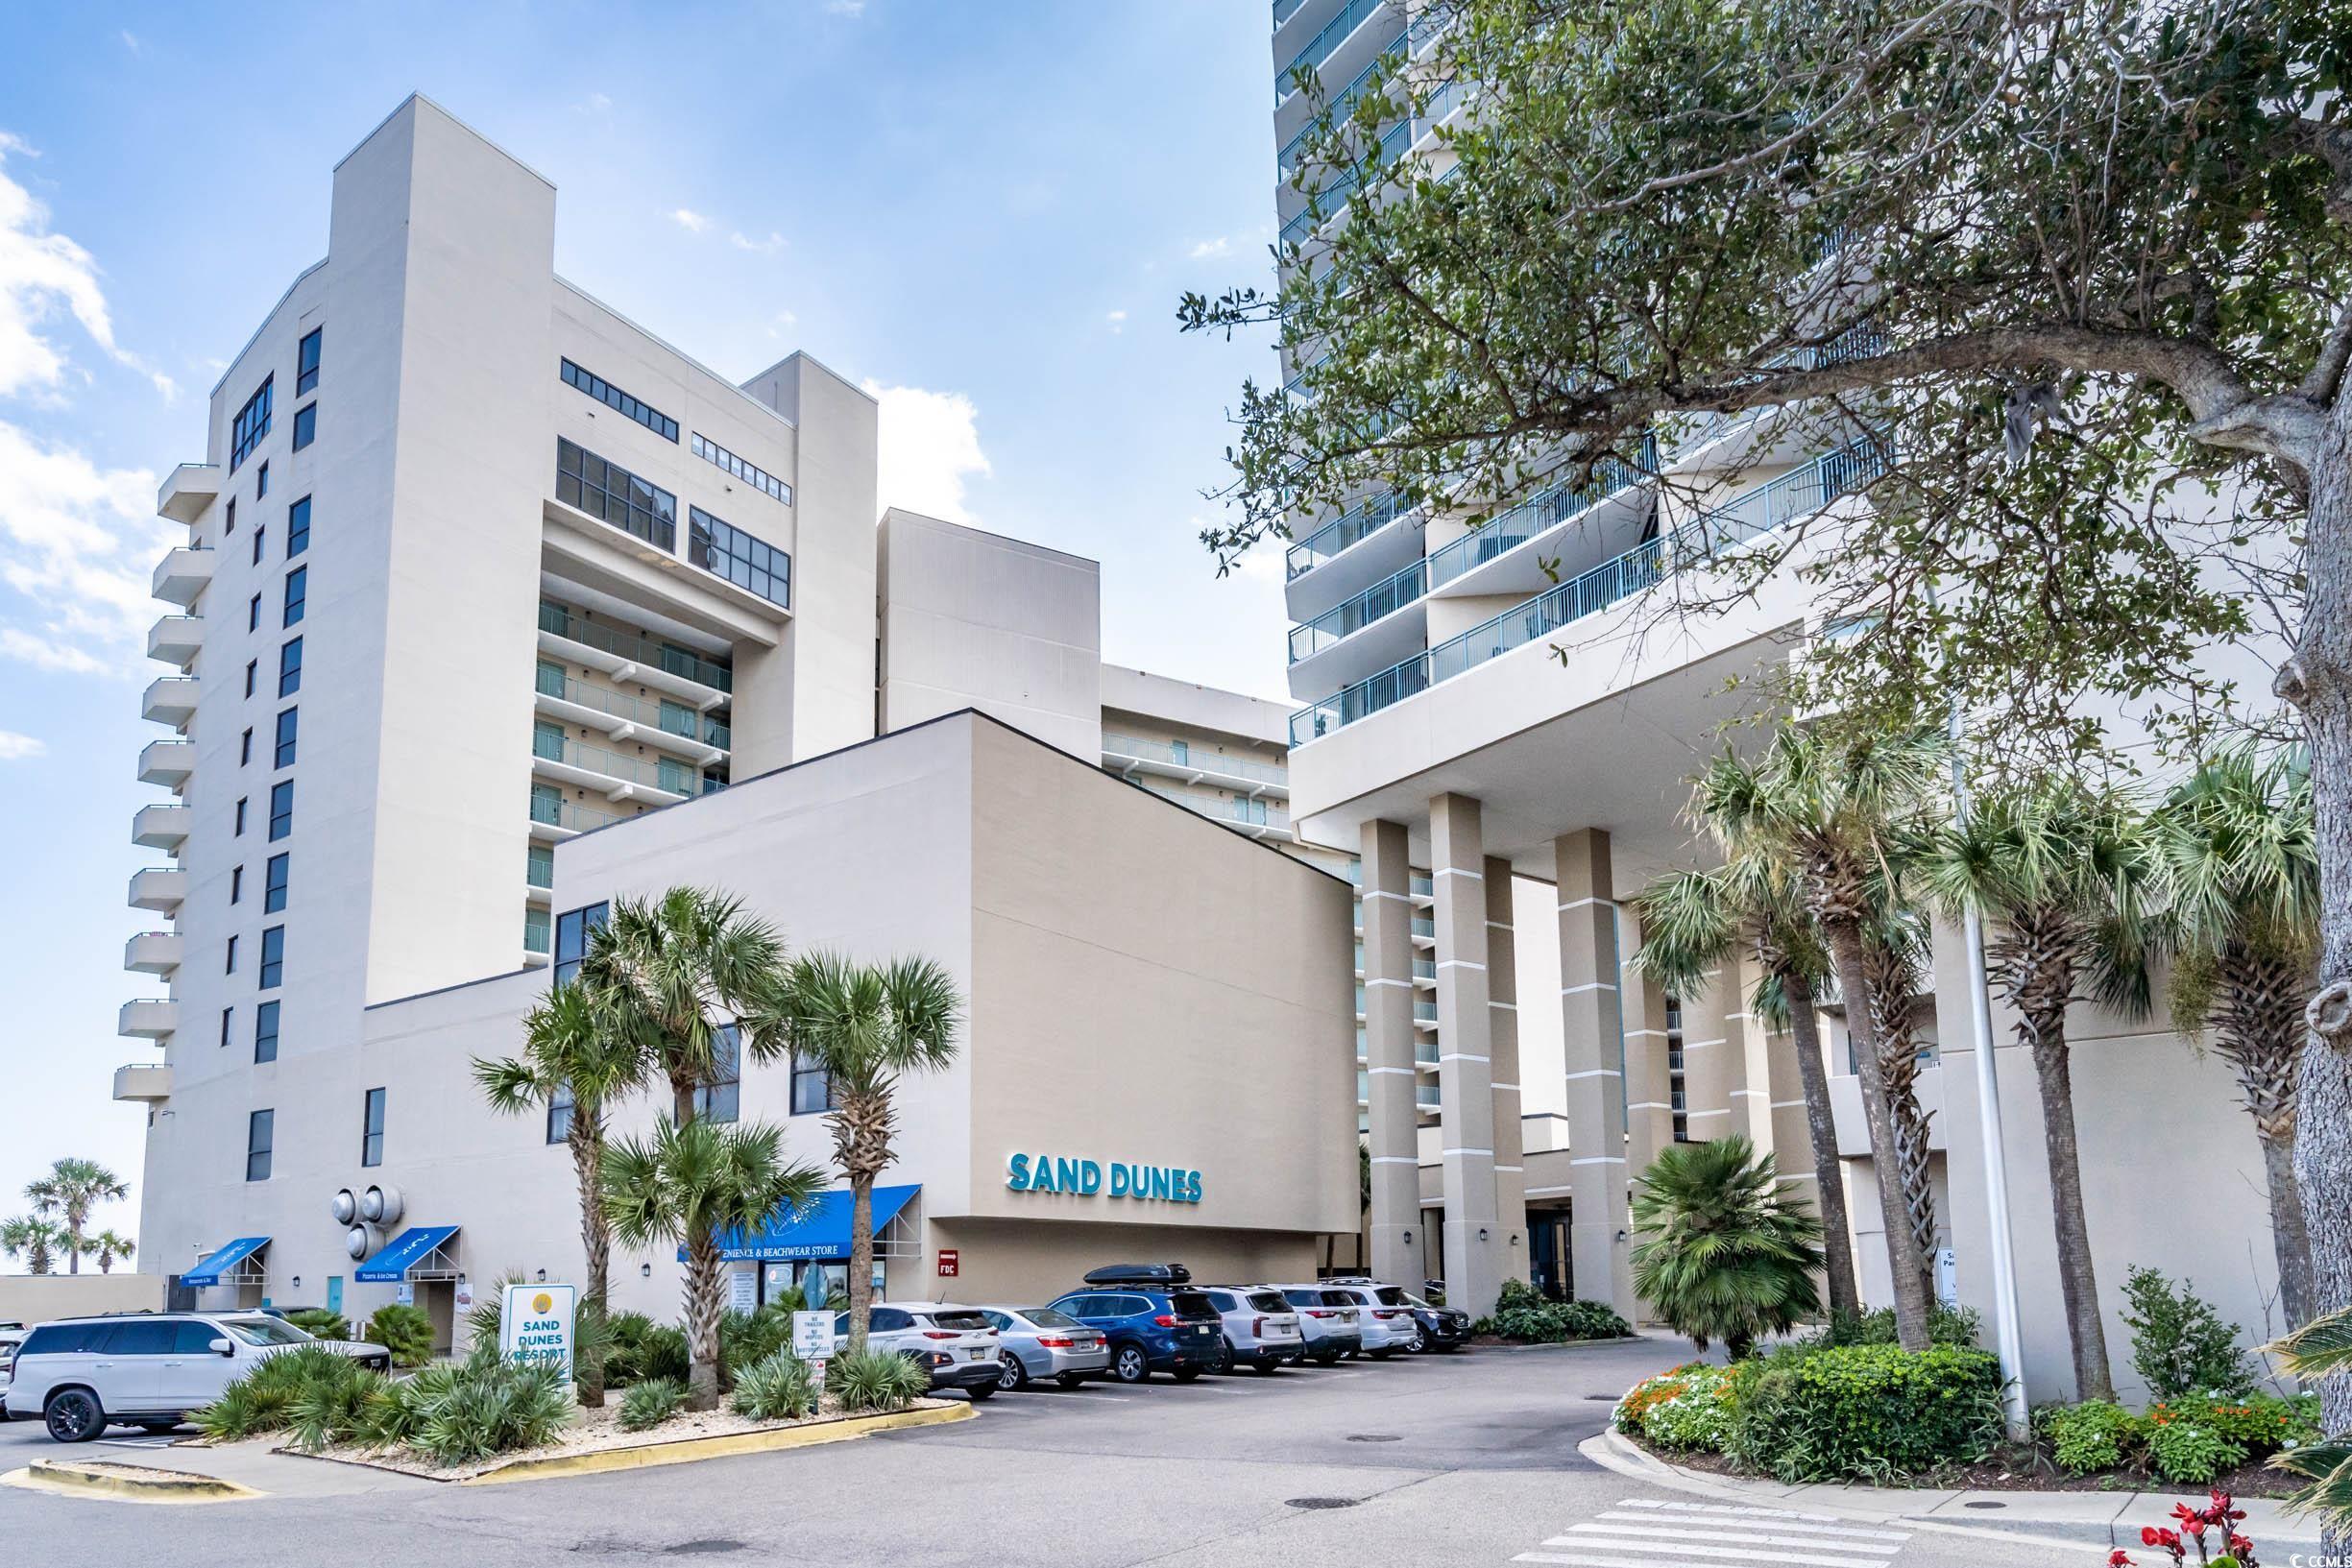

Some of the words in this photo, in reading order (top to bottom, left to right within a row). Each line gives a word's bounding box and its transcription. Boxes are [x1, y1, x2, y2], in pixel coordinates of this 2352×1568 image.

[1006, 1152, 1101, 1195] SAND
[1108, 1162, 1202, 1202] DUNES
[764, 1246, 811, 1257] BEACHWEAR
[812, 1244, 838, 1256] STORE
[940, 1265, 955, 1274] FDC
[523, 1320, 560, 1331] SAND
[519, 1335, 563, 1346] DUNES
